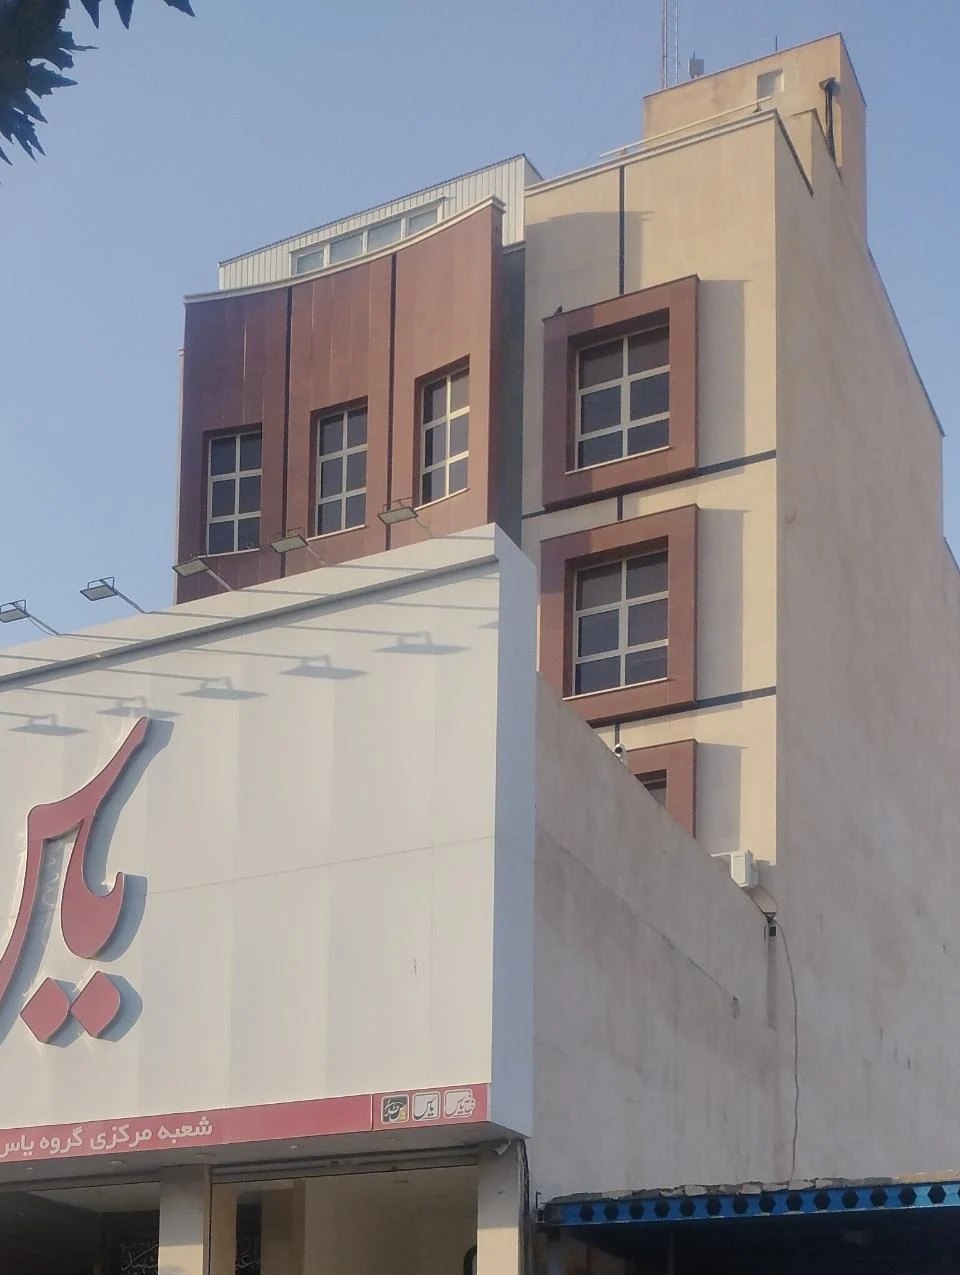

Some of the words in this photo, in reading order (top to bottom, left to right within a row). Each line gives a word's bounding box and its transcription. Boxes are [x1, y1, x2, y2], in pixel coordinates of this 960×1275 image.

[39, 1126, 83, 1154] گروه
[90, 1123, 153, 1150] مرکزی
[157, 1115, 213, 1144] شعبه
